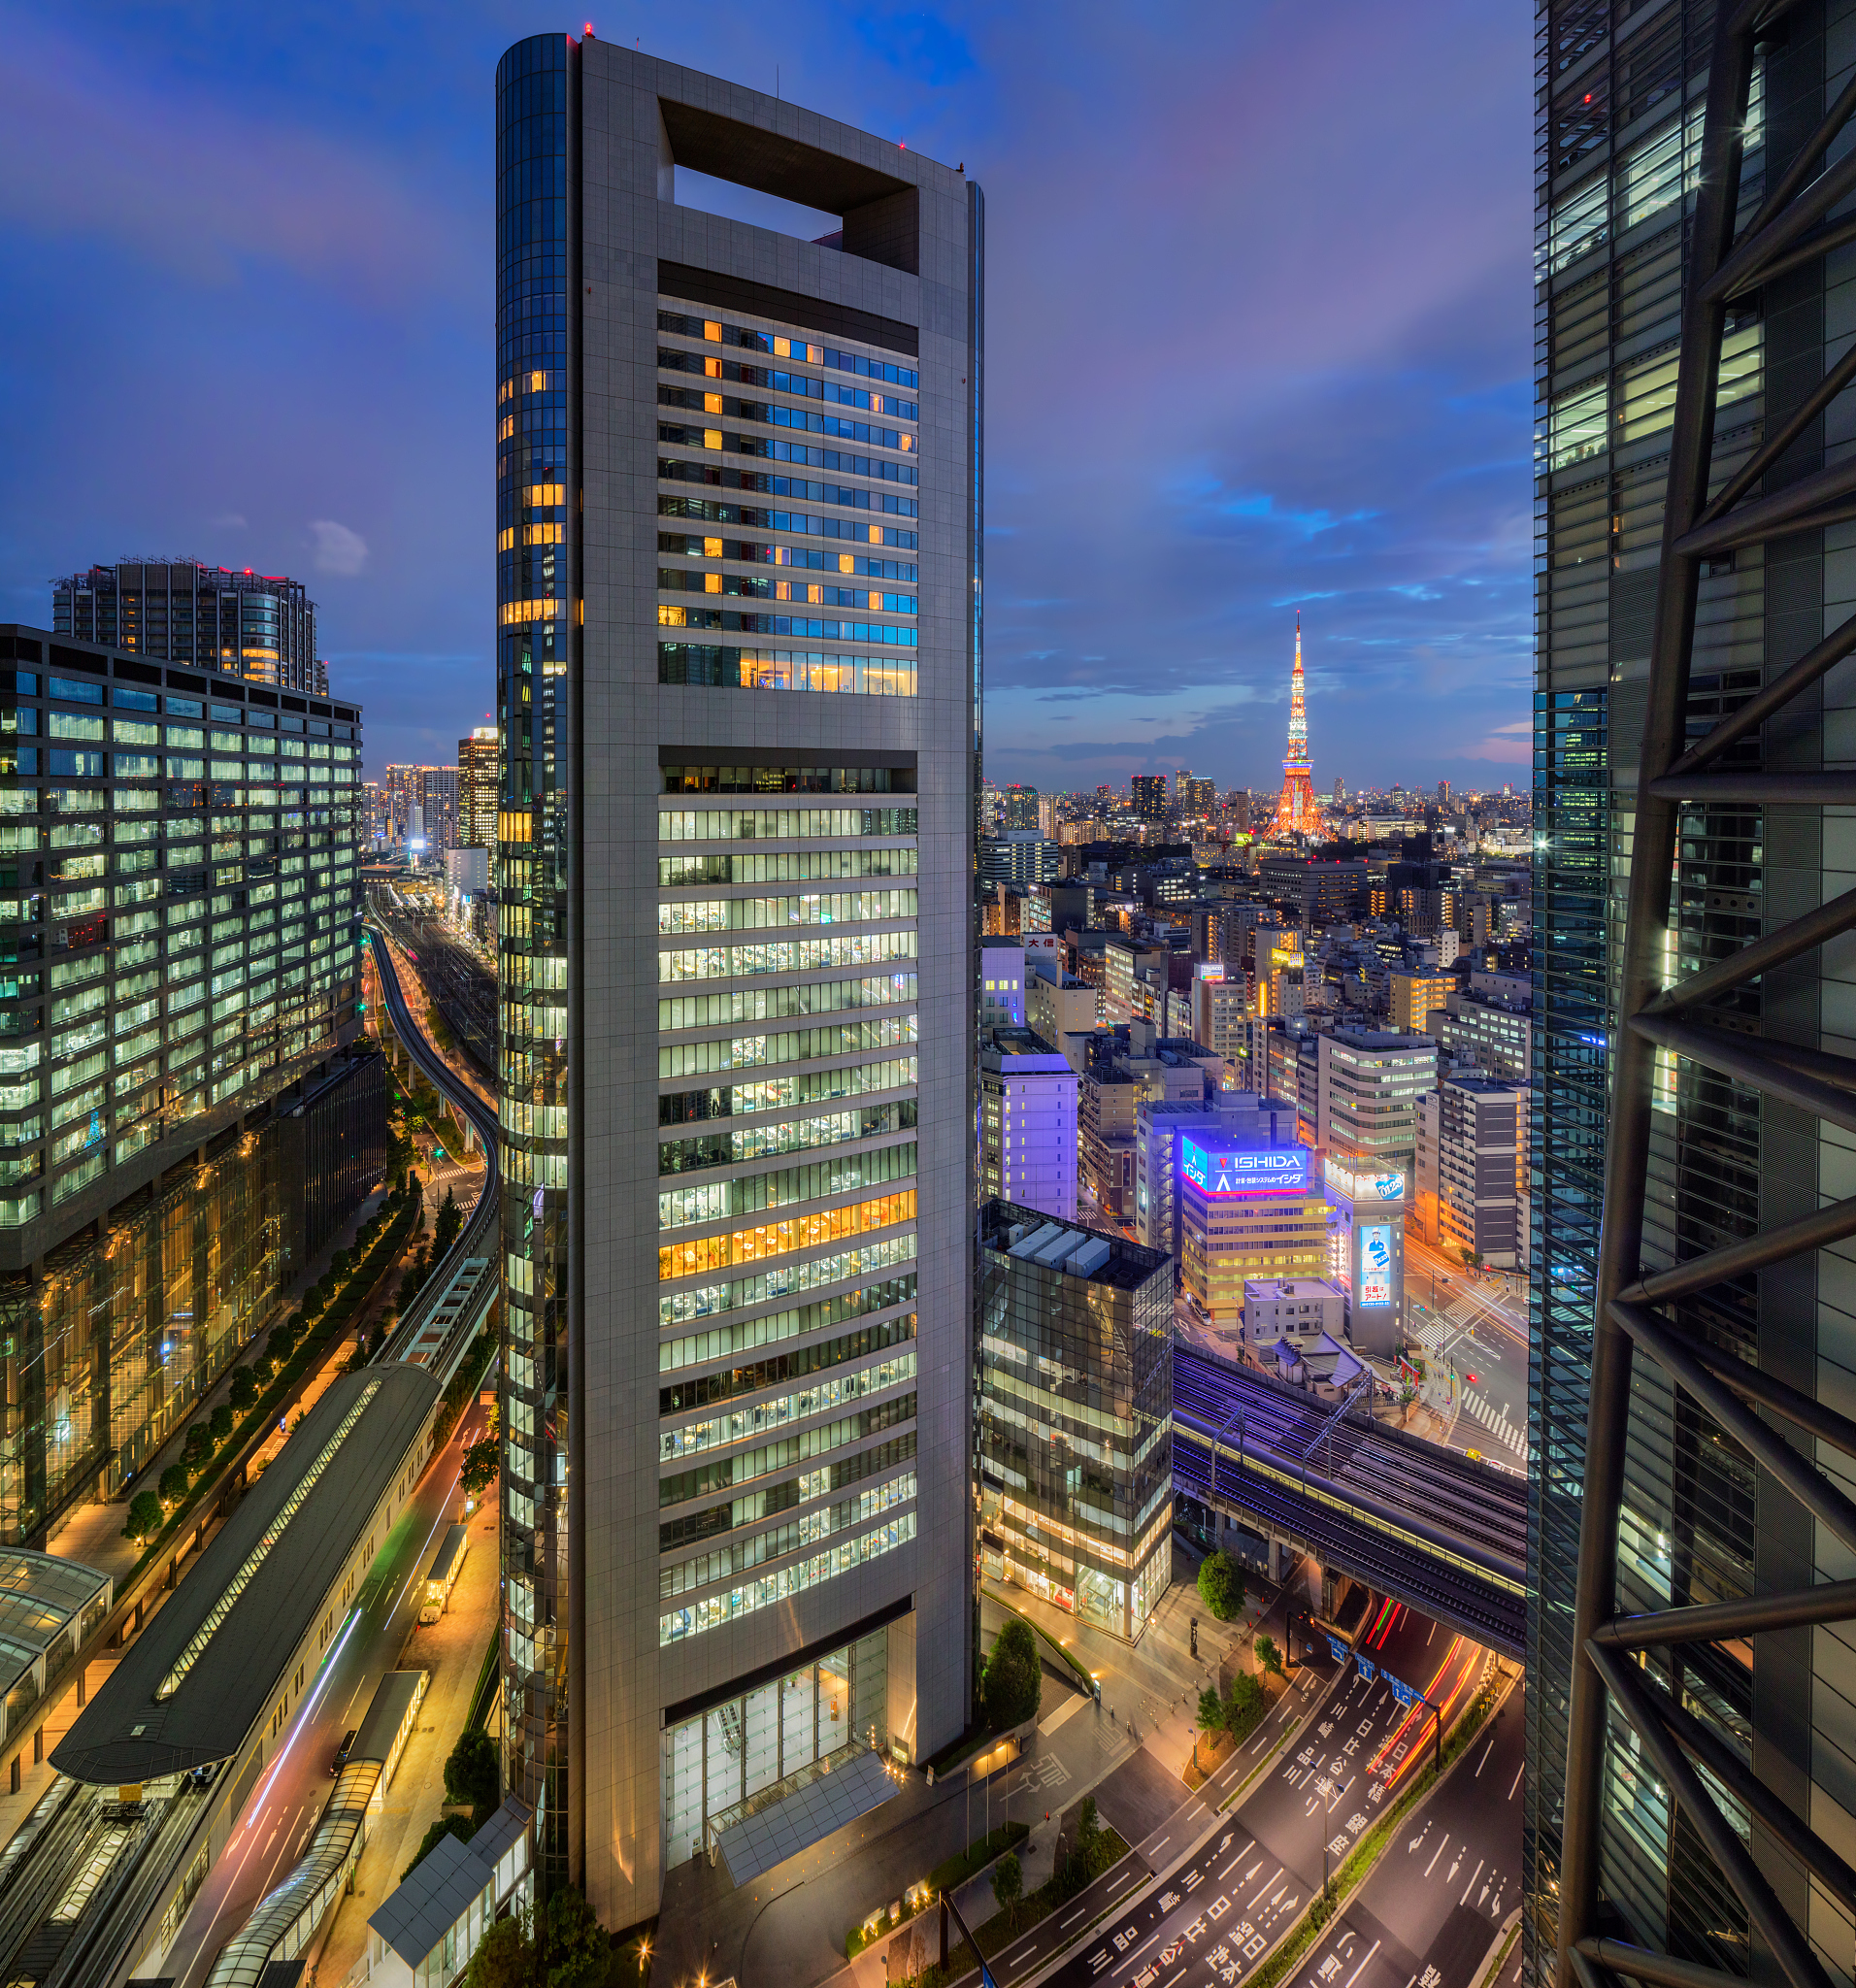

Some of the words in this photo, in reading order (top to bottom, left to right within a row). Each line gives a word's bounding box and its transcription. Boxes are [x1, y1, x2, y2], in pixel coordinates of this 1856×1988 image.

[1028, 938, 1054, 947] 大信
[1184, 1162, 1206, 1185] イシダ
[1235, 1155, 1301, 1169] ISHIDA
[1365, 1285, 1384, 1294] 引越は
[1030, 1754, 1068, 1788] STOP
[1306, 1718, 1374, 1817] 日比谷通り
[1120, 1895, 1232, 1988] 日比谷通
[1205, 1933, 1268, 1988] 日本
